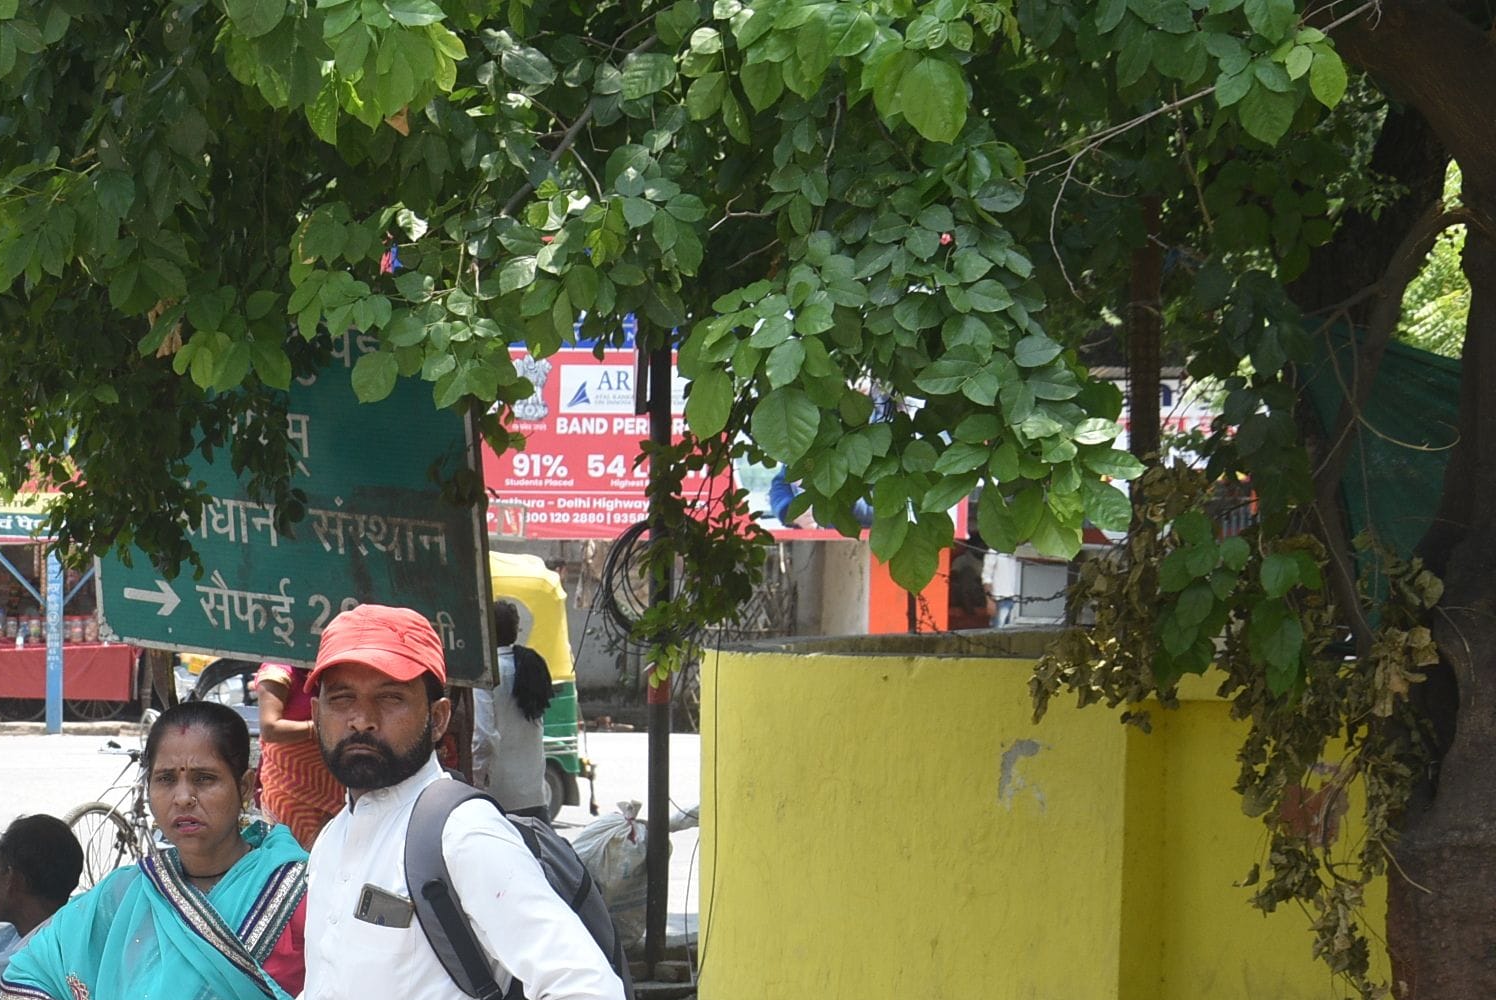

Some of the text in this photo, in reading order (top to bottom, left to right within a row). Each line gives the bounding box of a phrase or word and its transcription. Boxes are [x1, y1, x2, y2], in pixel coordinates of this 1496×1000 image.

[556, 417, 609, 435] BAND
[512, 453, 568, 478] 91%
[587, 453, 627, 478] 54
[504, 478, 644, 489] Students Placed Highest
[557, 497, 591, 509] Delhi
[550, 512, 604, 523] 120 2880
[308, 496, 448, 565] संस्थान
[195, 569, 295, 648] सैफई
